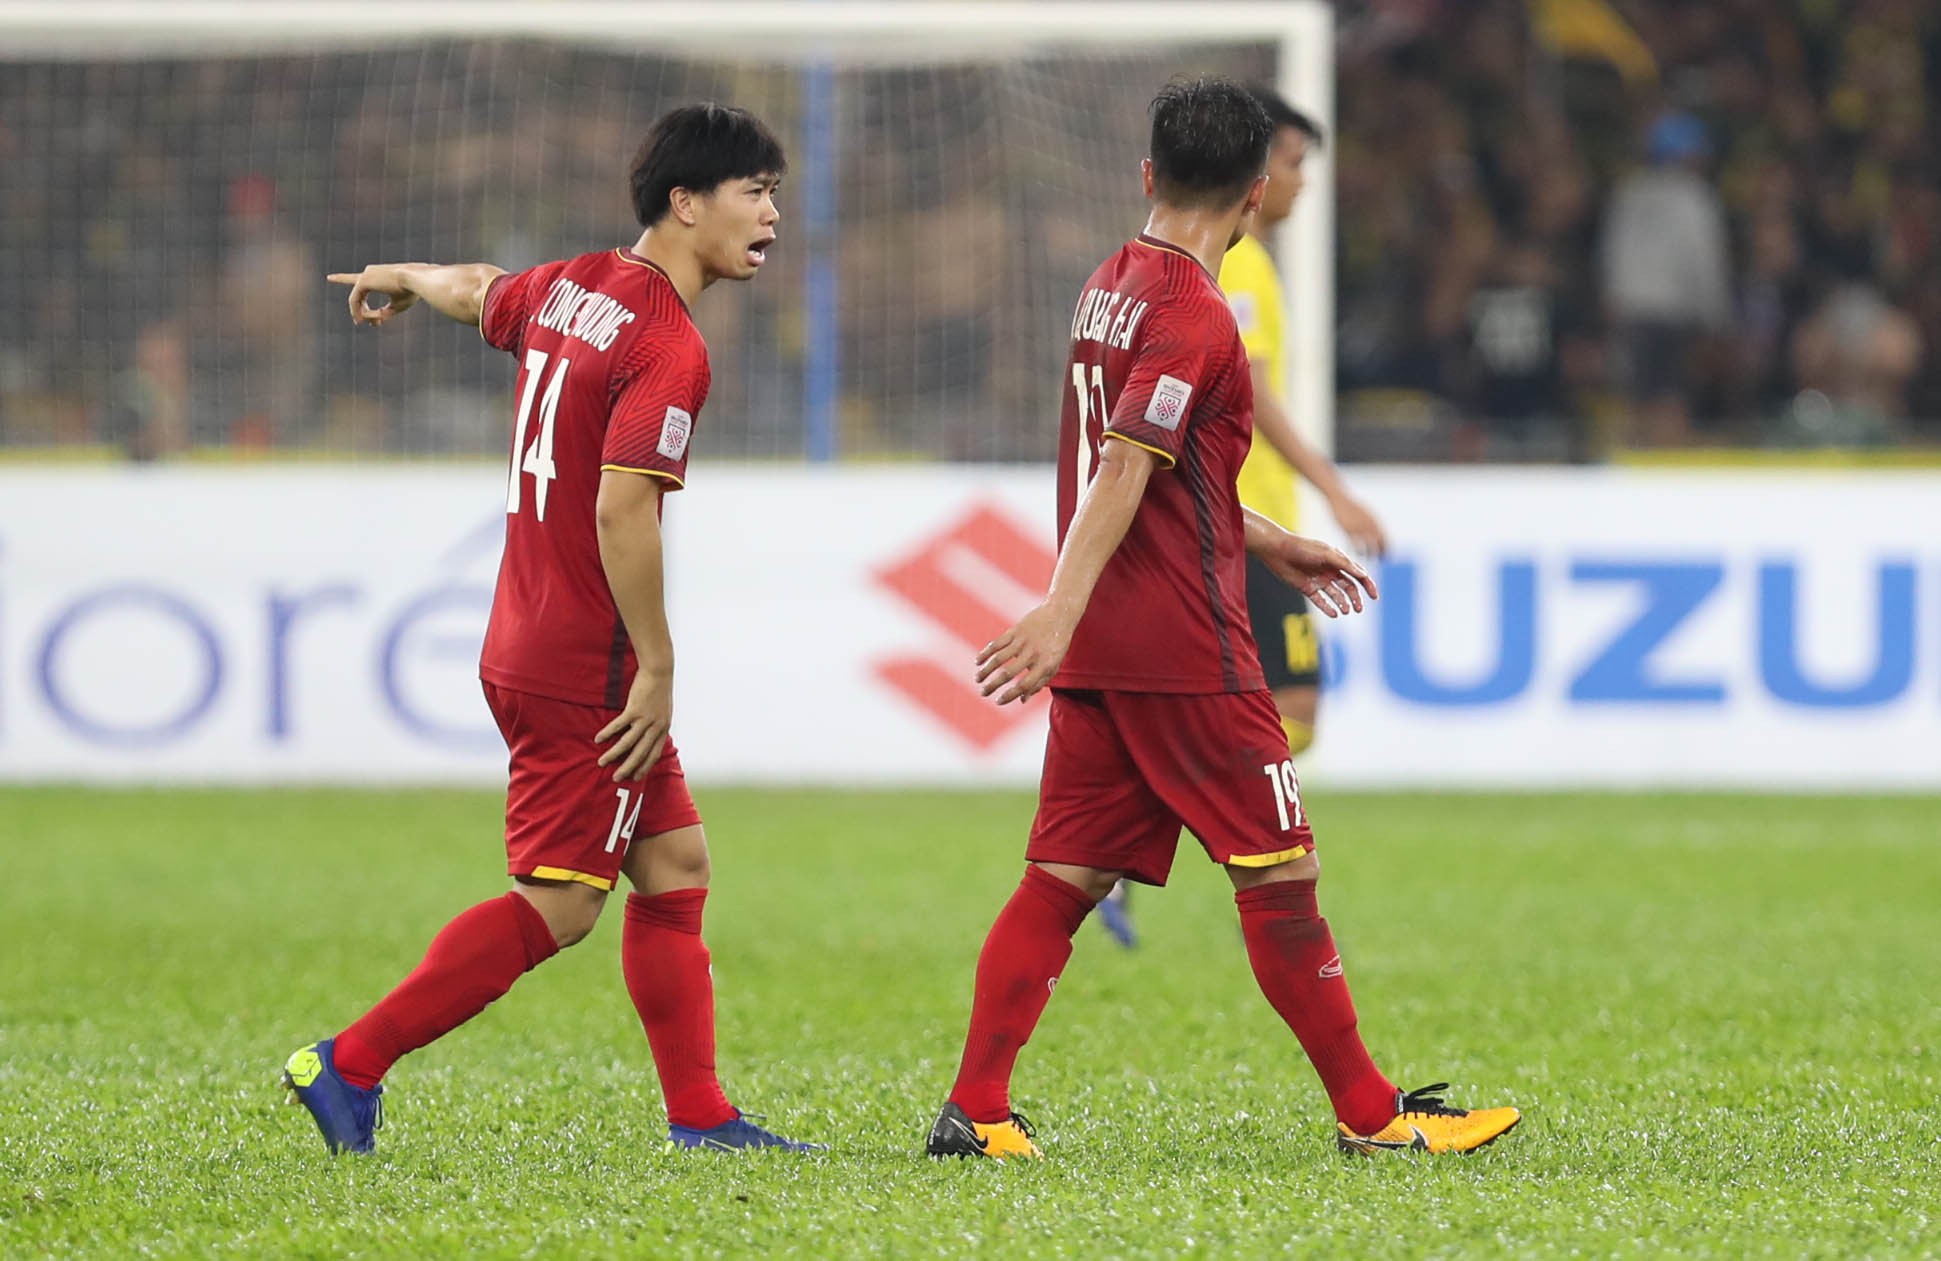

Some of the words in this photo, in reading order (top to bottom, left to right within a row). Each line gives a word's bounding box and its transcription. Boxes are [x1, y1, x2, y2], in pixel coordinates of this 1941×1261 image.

[507, 348, 570, 522] 14
[0, 505, 507, 753] oré
[1320, 555, 1941, 710] UZU
[604, 787, 644, 856] 14
[1264, 760, 1302, 831] 19
